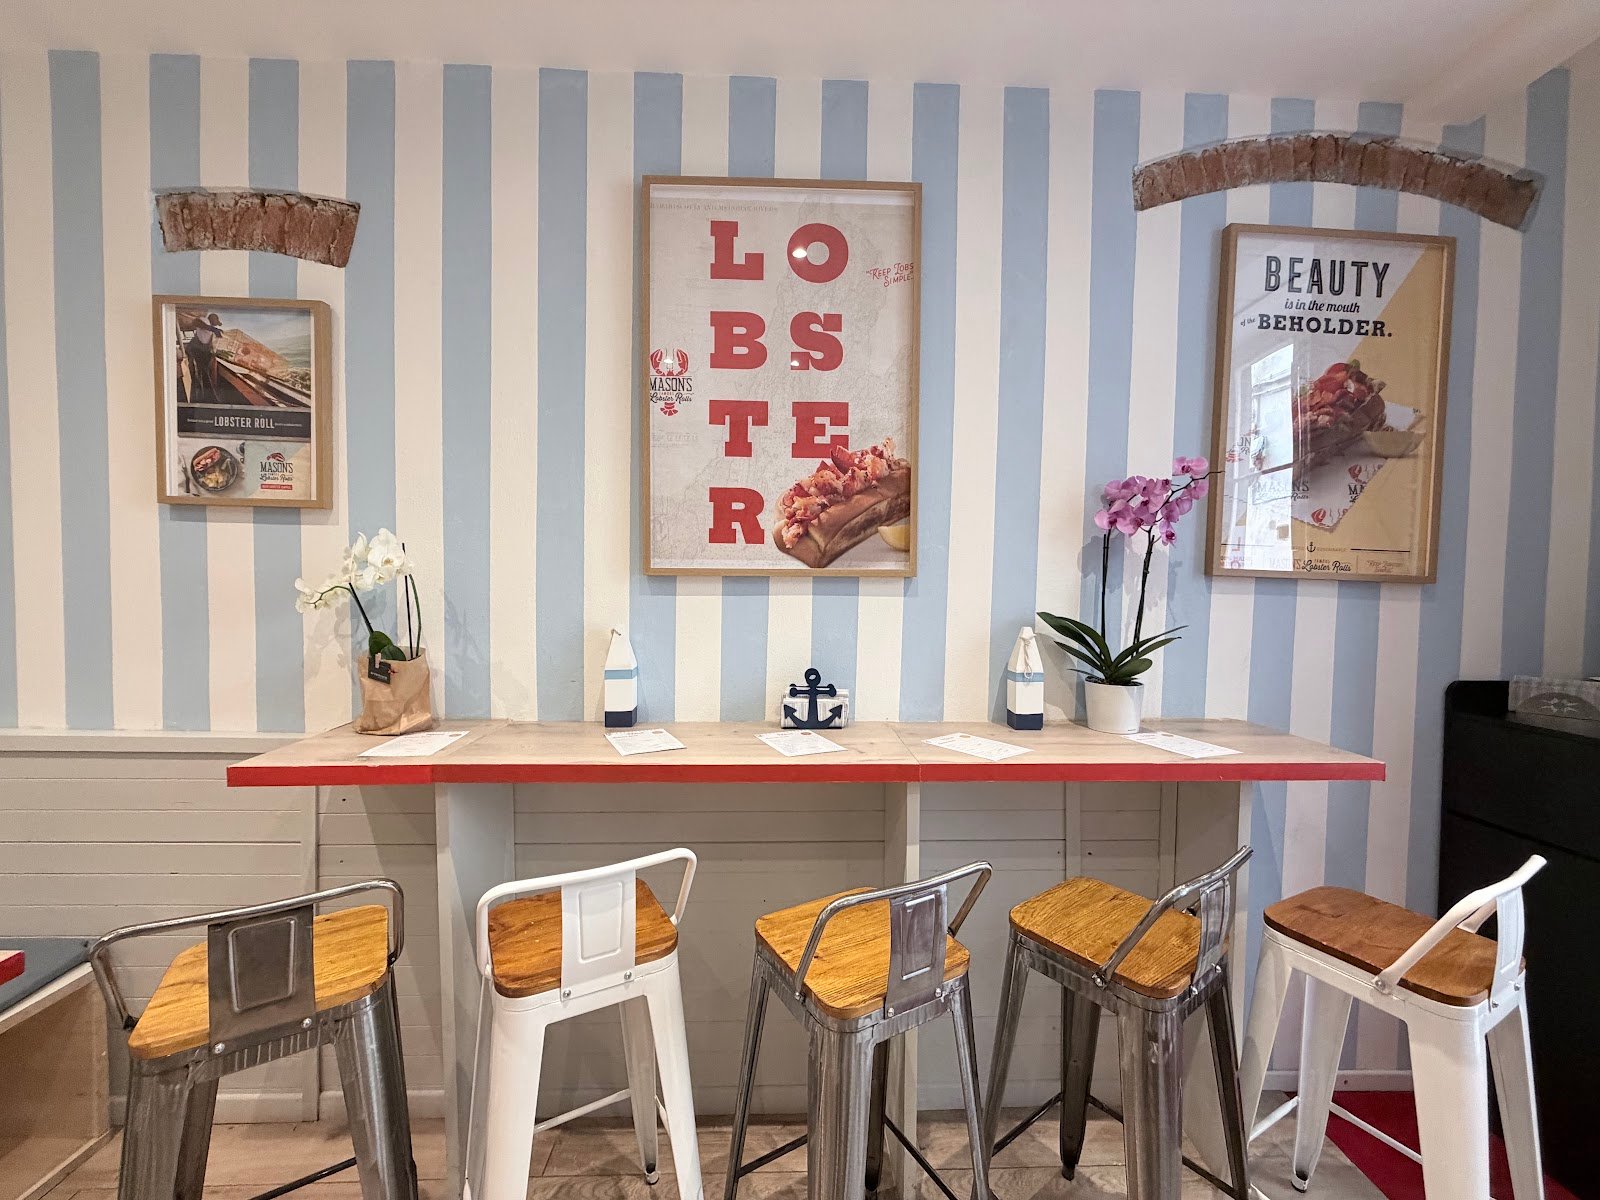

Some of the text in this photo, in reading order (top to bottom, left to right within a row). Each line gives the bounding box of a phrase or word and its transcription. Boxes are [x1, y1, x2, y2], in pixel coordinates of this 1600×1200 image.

[1265, 255, 1390, 298] BEAUTY
[1284, 298, 1360, 313] is in the mouth
[1257, 313, 1393, 338] BEHOLDER.
[214, 416, 275, 429] LOBSTER ROLL
[1302, 559, 1330, 573] Lobster
[1332, 560, 1351, 574] Rolls
